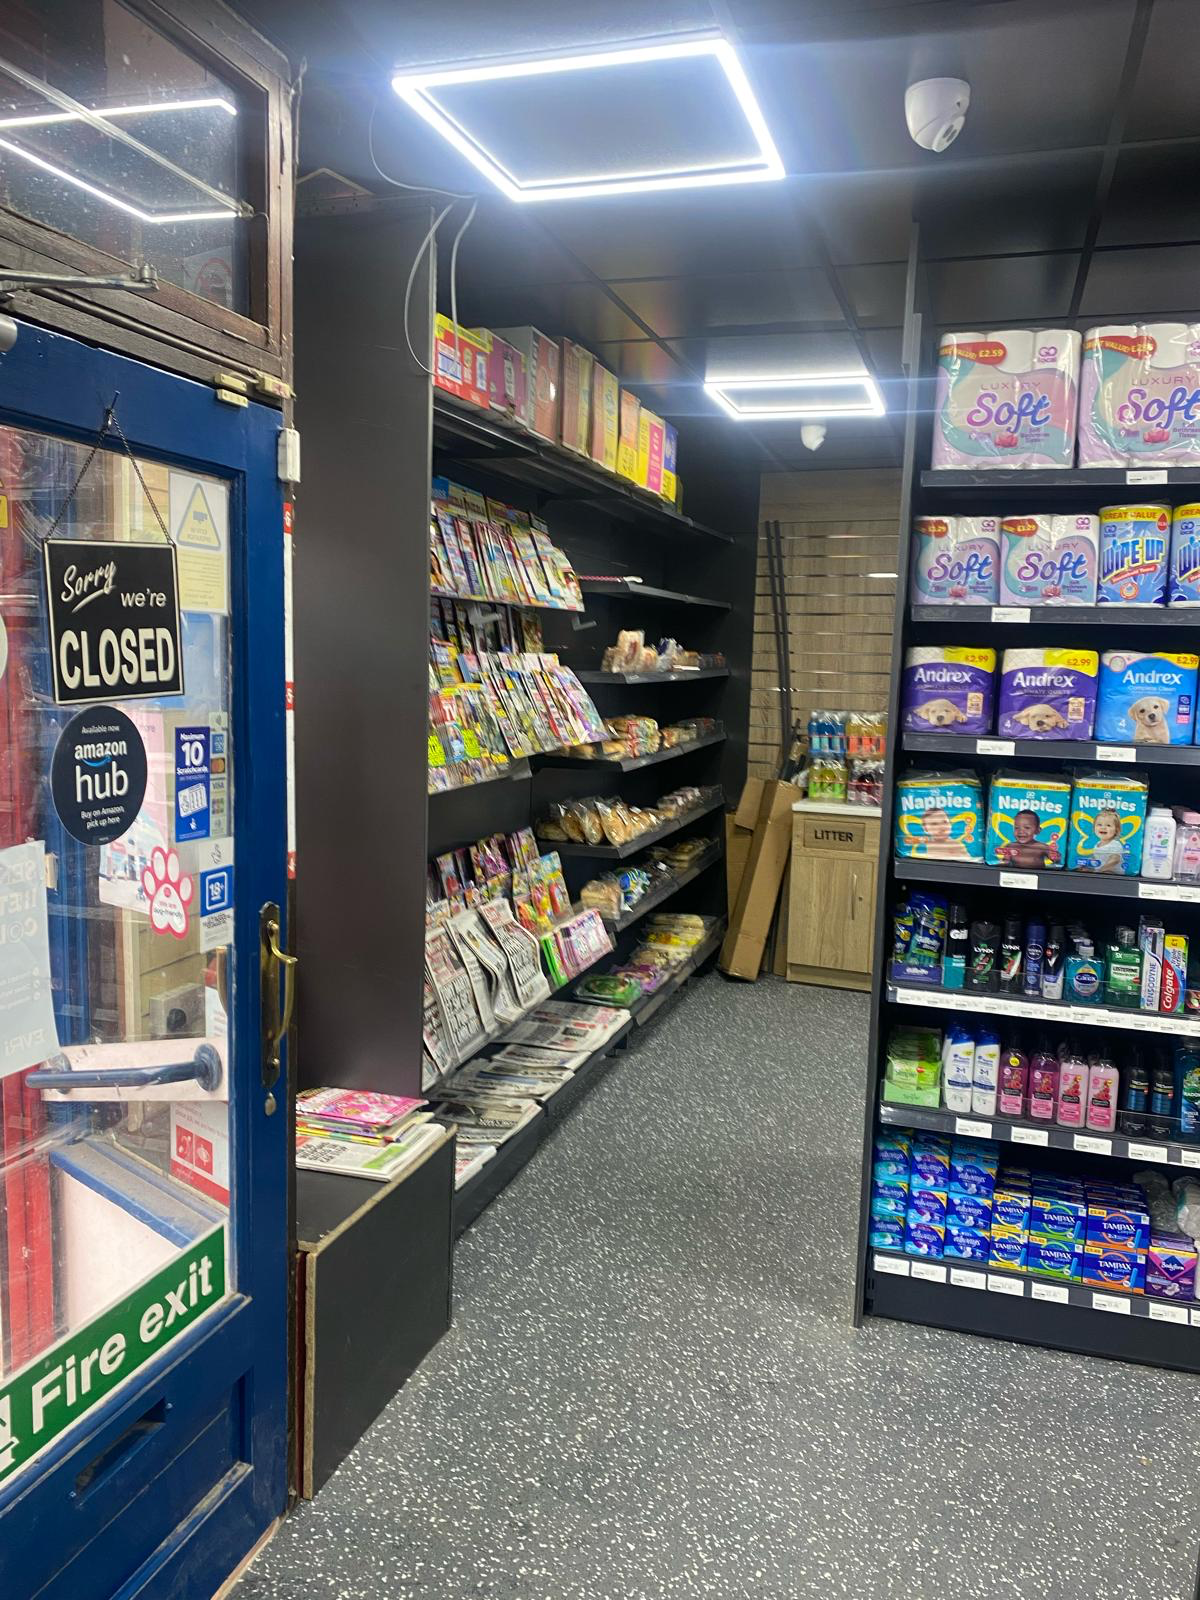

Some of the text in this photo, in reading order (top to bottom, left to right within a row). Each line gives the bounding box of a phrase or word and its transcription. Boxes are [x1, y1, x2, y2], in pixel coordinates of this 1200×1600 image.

[981, 381, 1041, 391] LUXURY
[1131, 375, 1196, 386] LUXURY
[966, 392, 1051, 434] Soft
[1117, 387, 1200, 430] Soft
[1027, 542, 1079, 552] LUXURY
[1144, 538, 1166, 562] UP
[927, 552, 993, 586] Soft
[1016, 551, 1088, 586] Soft
[60, 560, 118, 603] Sorry
[120, 588, 167, 608] we're
[59, 627, 175, 690] CLOSED
[965, 655, 990, 663] £2.99
[1066, 658, 1092, 667] £2.99
[1176, 656, 1199, 665] £2.99
[913, 667, 973, 684] Andrex
[1012, 671, 1075, 688] Andrex
[1122, 669, 1183, 686] Andrex
[81, 725, 107, 734] Available
[74, 740, 128, 760] amazon
[181, 740, 205, 767] 10
[75, 760, 129, 803] hub
[901, 791, 972, 811] Nappies
[998, 795, 1063, 814] Nappies
[1079, 795, 1137, 812] Nappies
[86, 820, 98, 830] pick
[107, 816, 121, 825] here
[814, 829, 854, 842] LITTER
[973, 946, 994, 954] LYNX
[1146, 962, 1158, 1008] SENSODYNE
[1163, 967, 1176, 1009] Colgate
[997, 1205, 1025, 1216] TAMPAX
[1042, 1213, 1077, 1225] TAMPAX
[1101, 1221, 1137, 1232] TAMPAX
[994, 1242, 1022, 1252] TAMPAX
[1039, 1248, 1073, 1260] TAMPAX
[1097, 1260, 1132, 1271] TAMPAX
[31, 1254, 213, 1435] Fire exit
